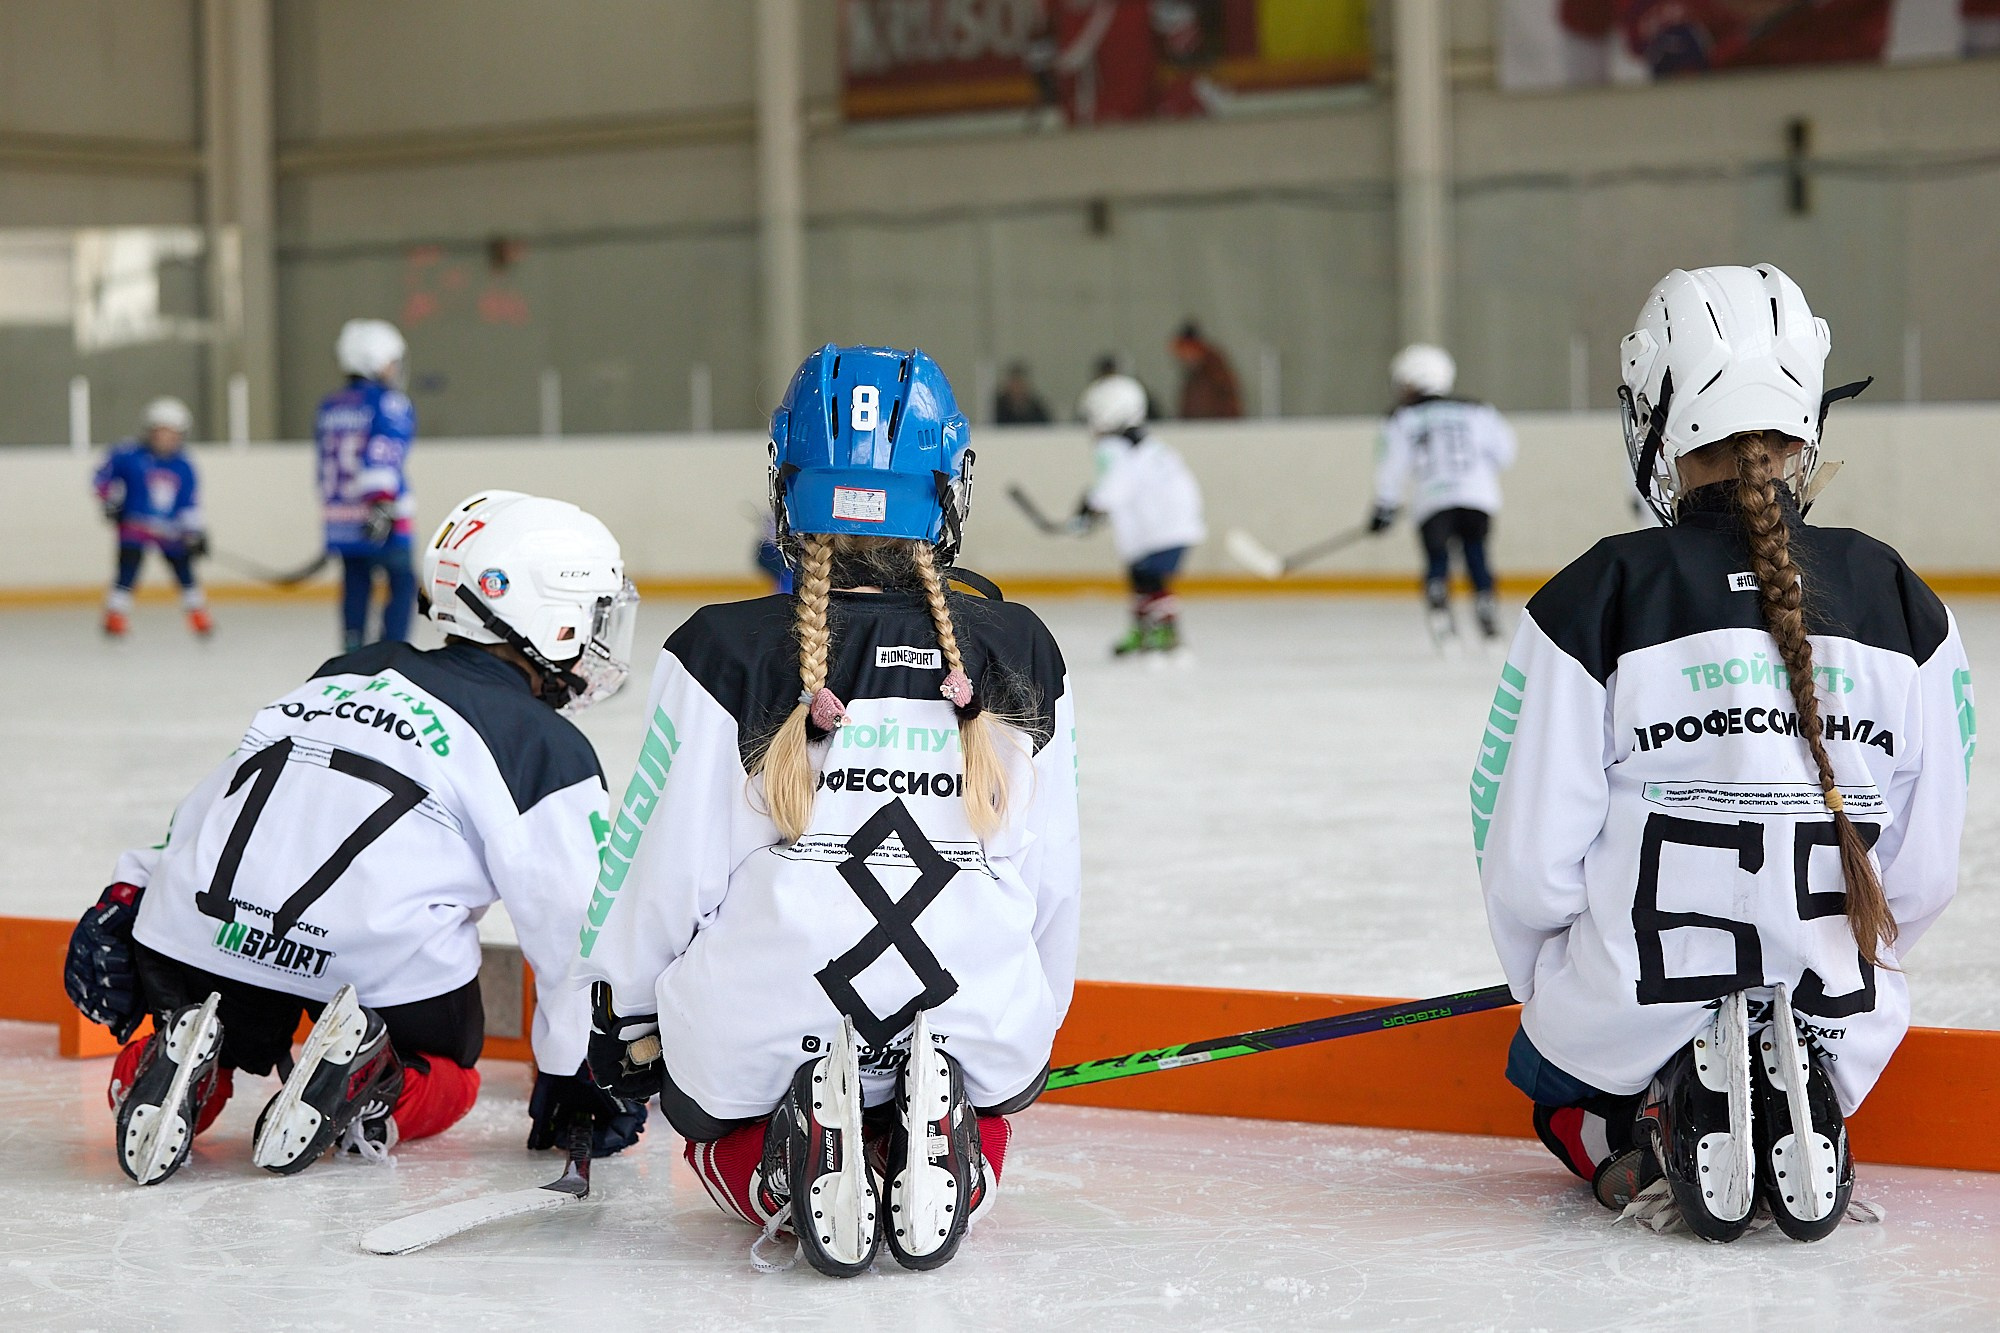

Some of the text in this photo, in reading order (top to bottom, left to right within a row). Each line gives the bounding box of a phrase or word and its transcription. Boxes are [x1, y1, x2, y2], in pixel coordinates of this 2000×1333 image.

[851, 385, 879, 431] 8
[880, 649, 935, 666] #IONESPORT
[1682, 653, 1772, 692] ТВОЙ
[906, 728, 962, 752] ПУТ
[195, 736, 429, 942] 17
[294, 921, 329, 938] OCKEY
[813, 795, 960, 1048] 8
[213, 922, 333, 976] INSPORT
[826, 1130, 835, 1171] BAUER
[927, 1124, 938, 1165] BAR
